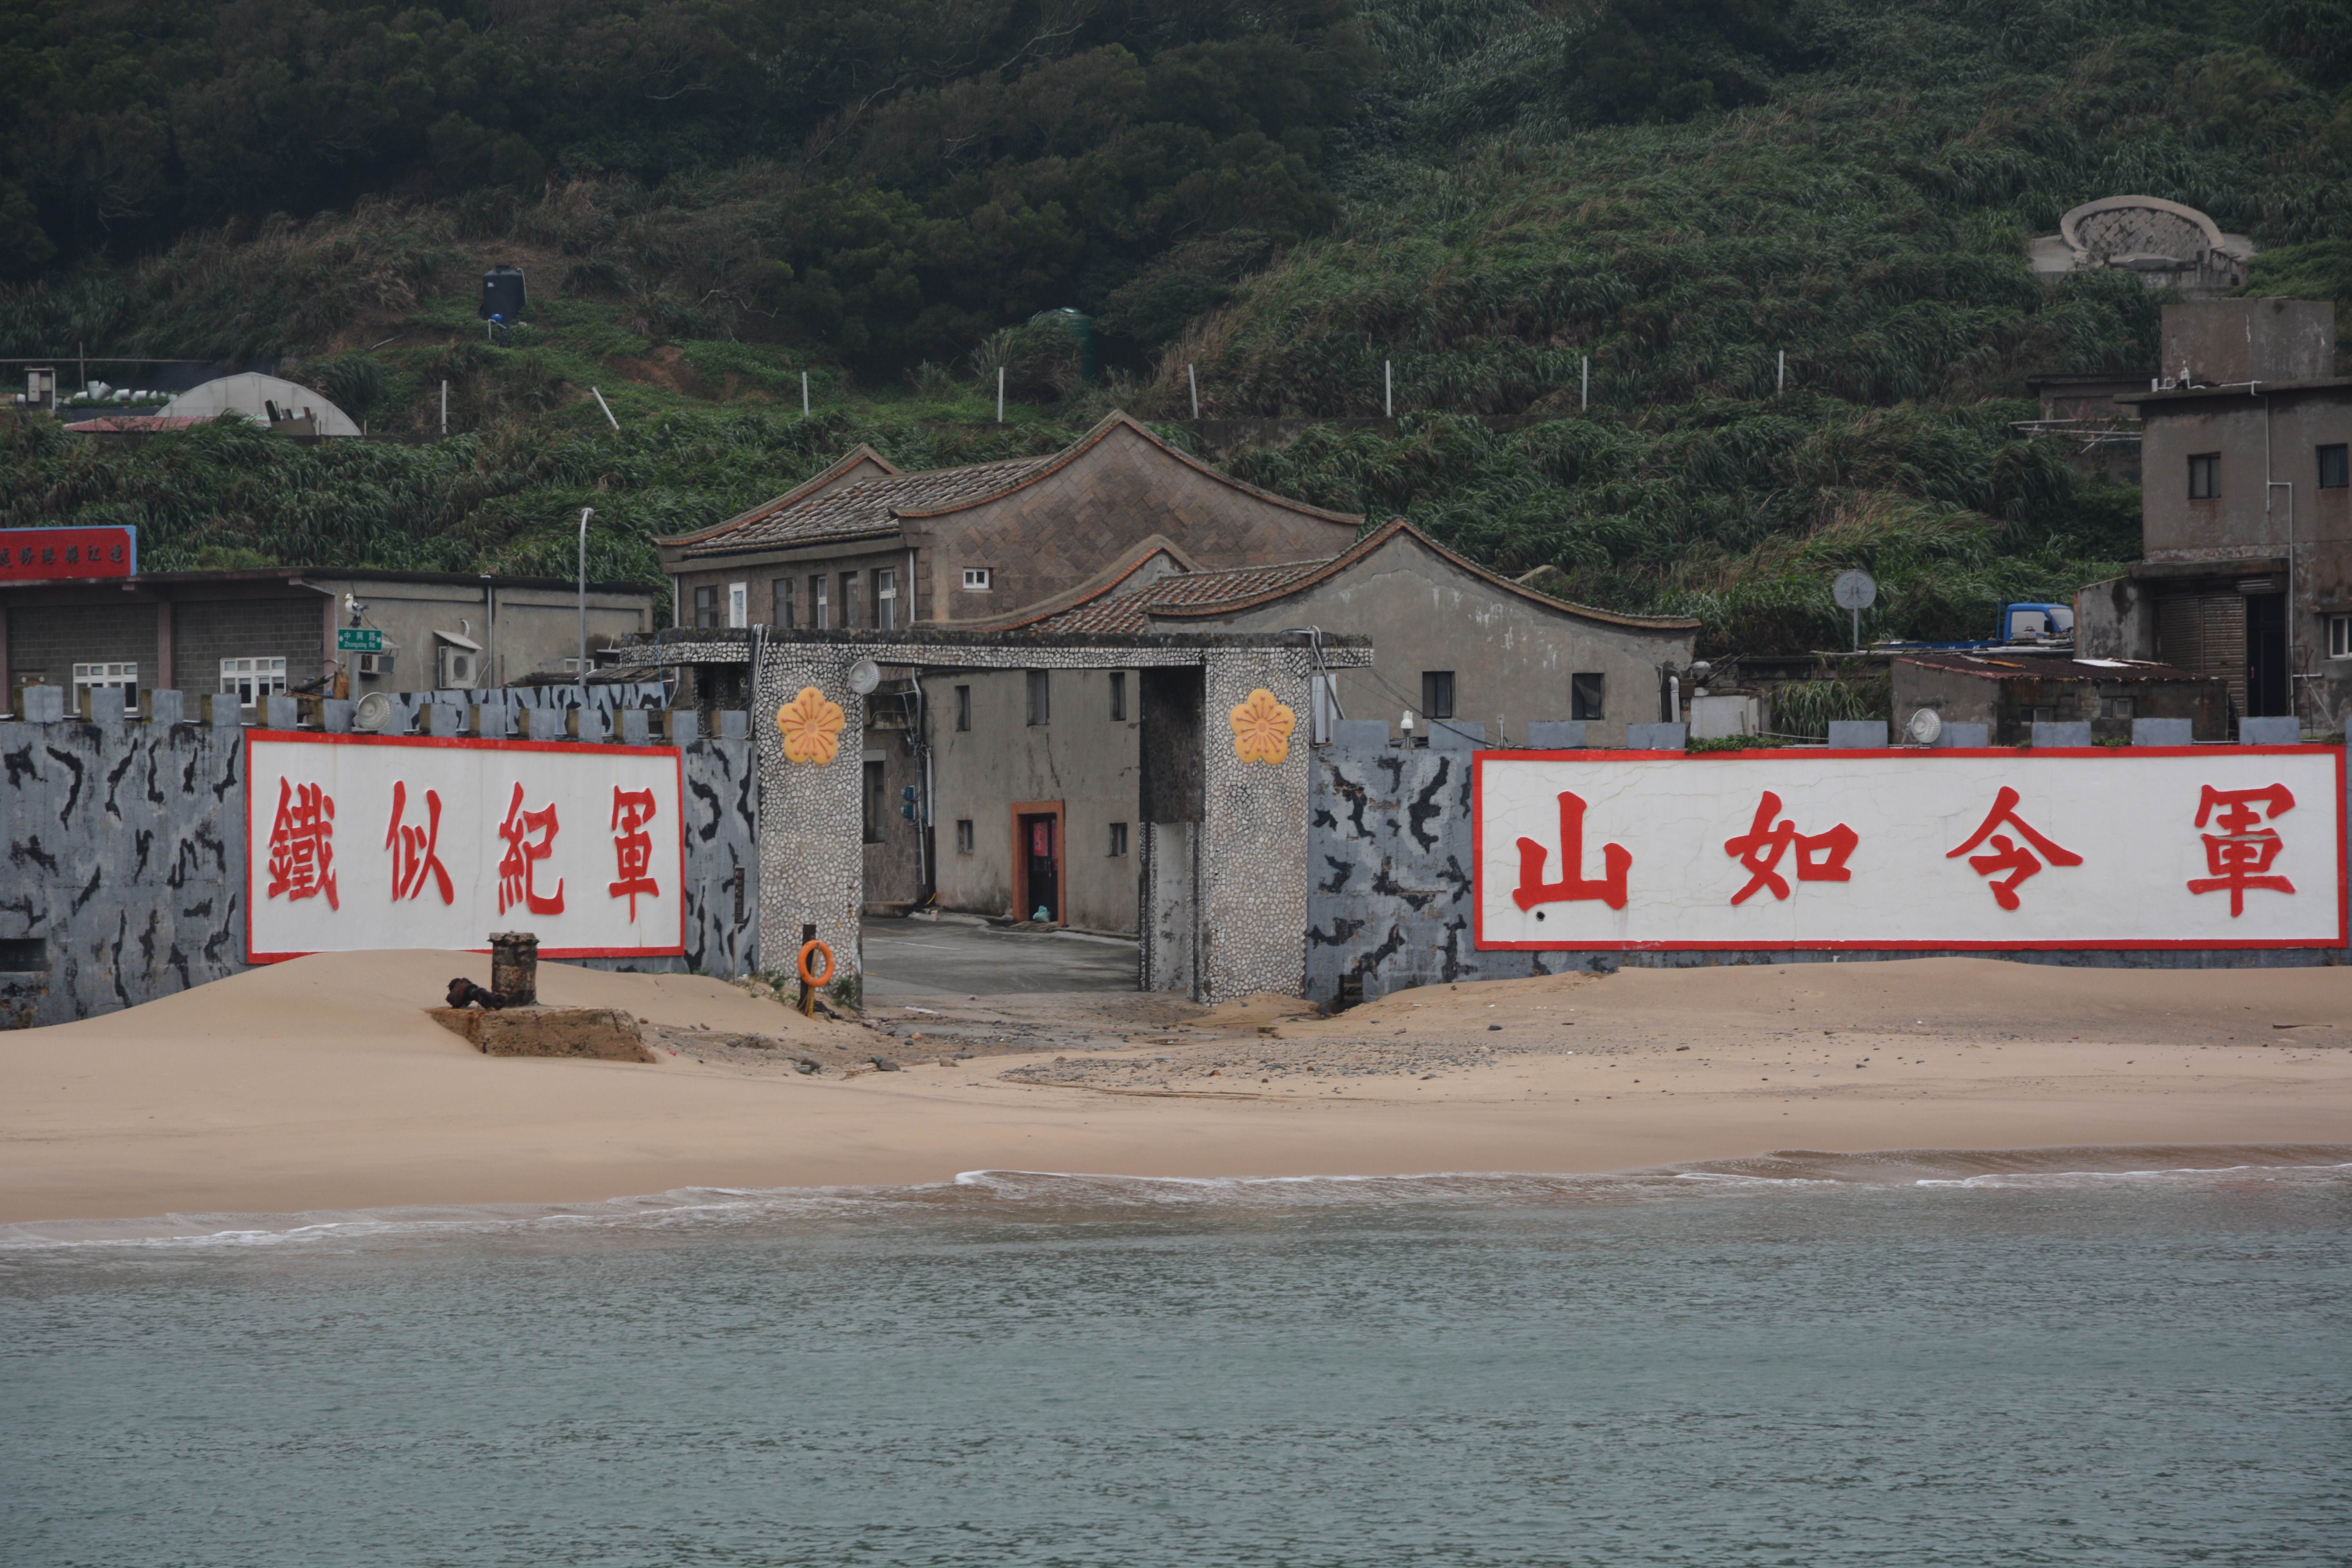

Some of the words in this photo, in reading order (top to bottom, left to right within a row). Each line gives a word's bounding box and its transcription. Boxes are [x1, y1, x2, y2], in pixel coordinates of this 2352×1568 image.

[344, 631, 376, 641] 中興路
[344, 641, 367, 649] Zhongxing
[1512, 783, 2296, 917] 軍令如山
